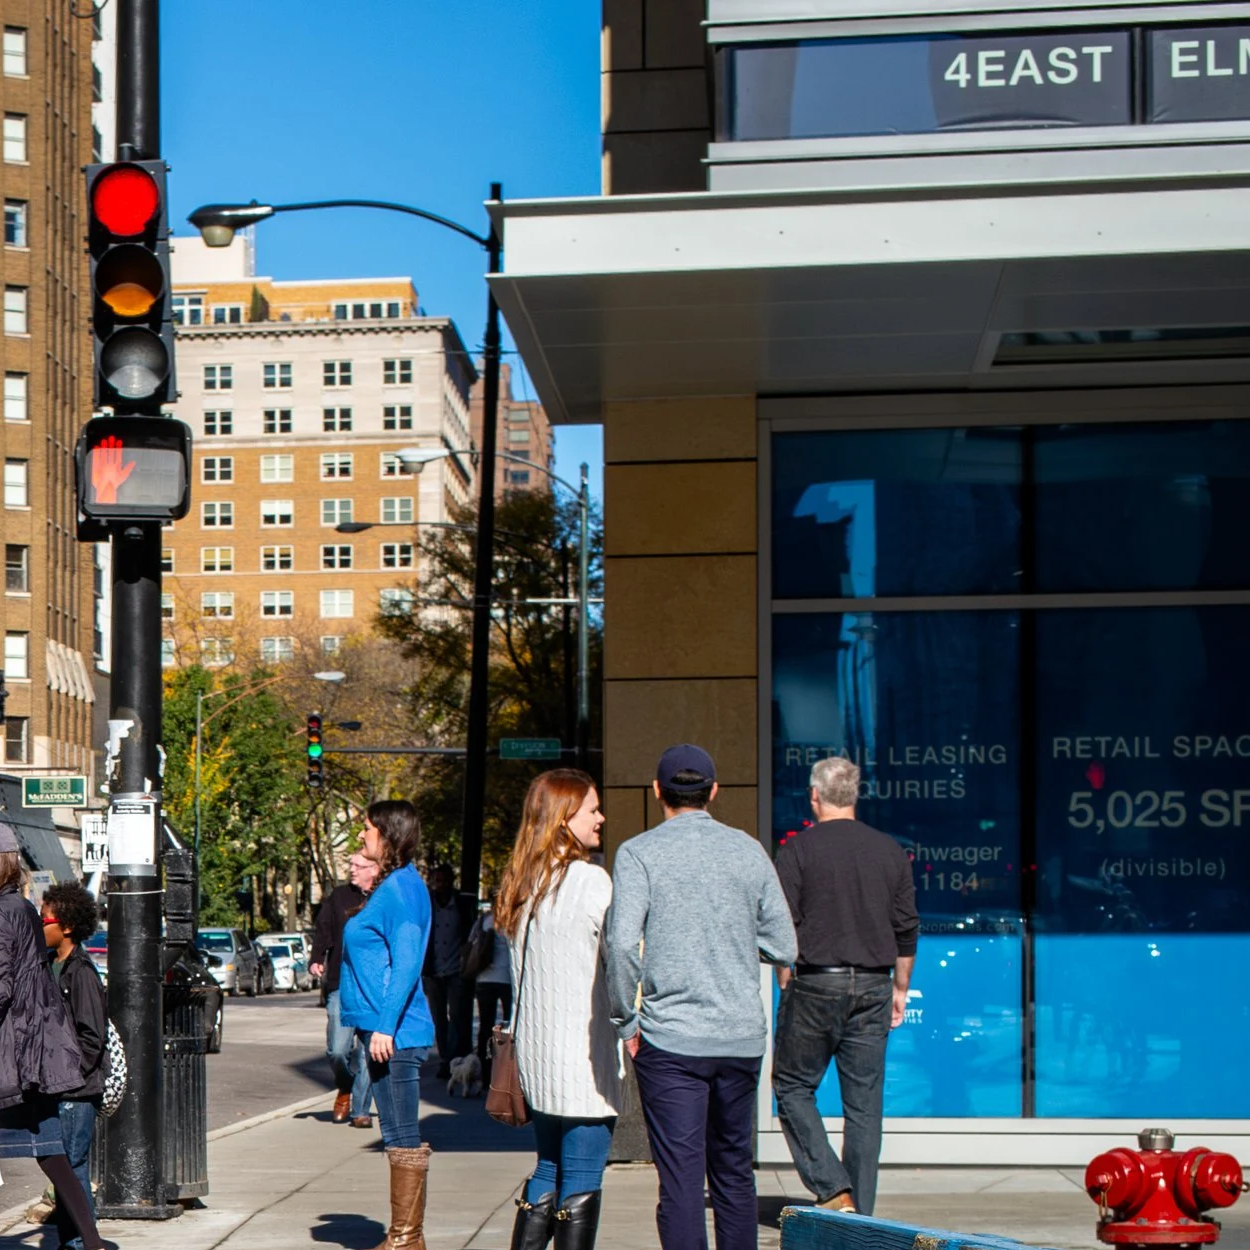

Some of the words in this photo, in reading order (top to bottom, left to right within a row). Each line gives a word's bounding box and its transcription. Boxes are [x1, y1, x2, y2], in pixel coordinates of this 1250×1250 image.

[944, 46, 1112, 88] 4EAST
[1171, 38, 1250, 78] EL
[786, 747, 877, 765] RETAIL
[889, 745, 1007, 764] LEASING
[1053, 737, 1160, 758] RETAIL
[857, 780, 966, 799] QUIRIES
[1068, 791, 1187, 834] 5,025
[903, 842, 1002, 866] chwager
[1102, 858, 1226, 880] (divisible)
